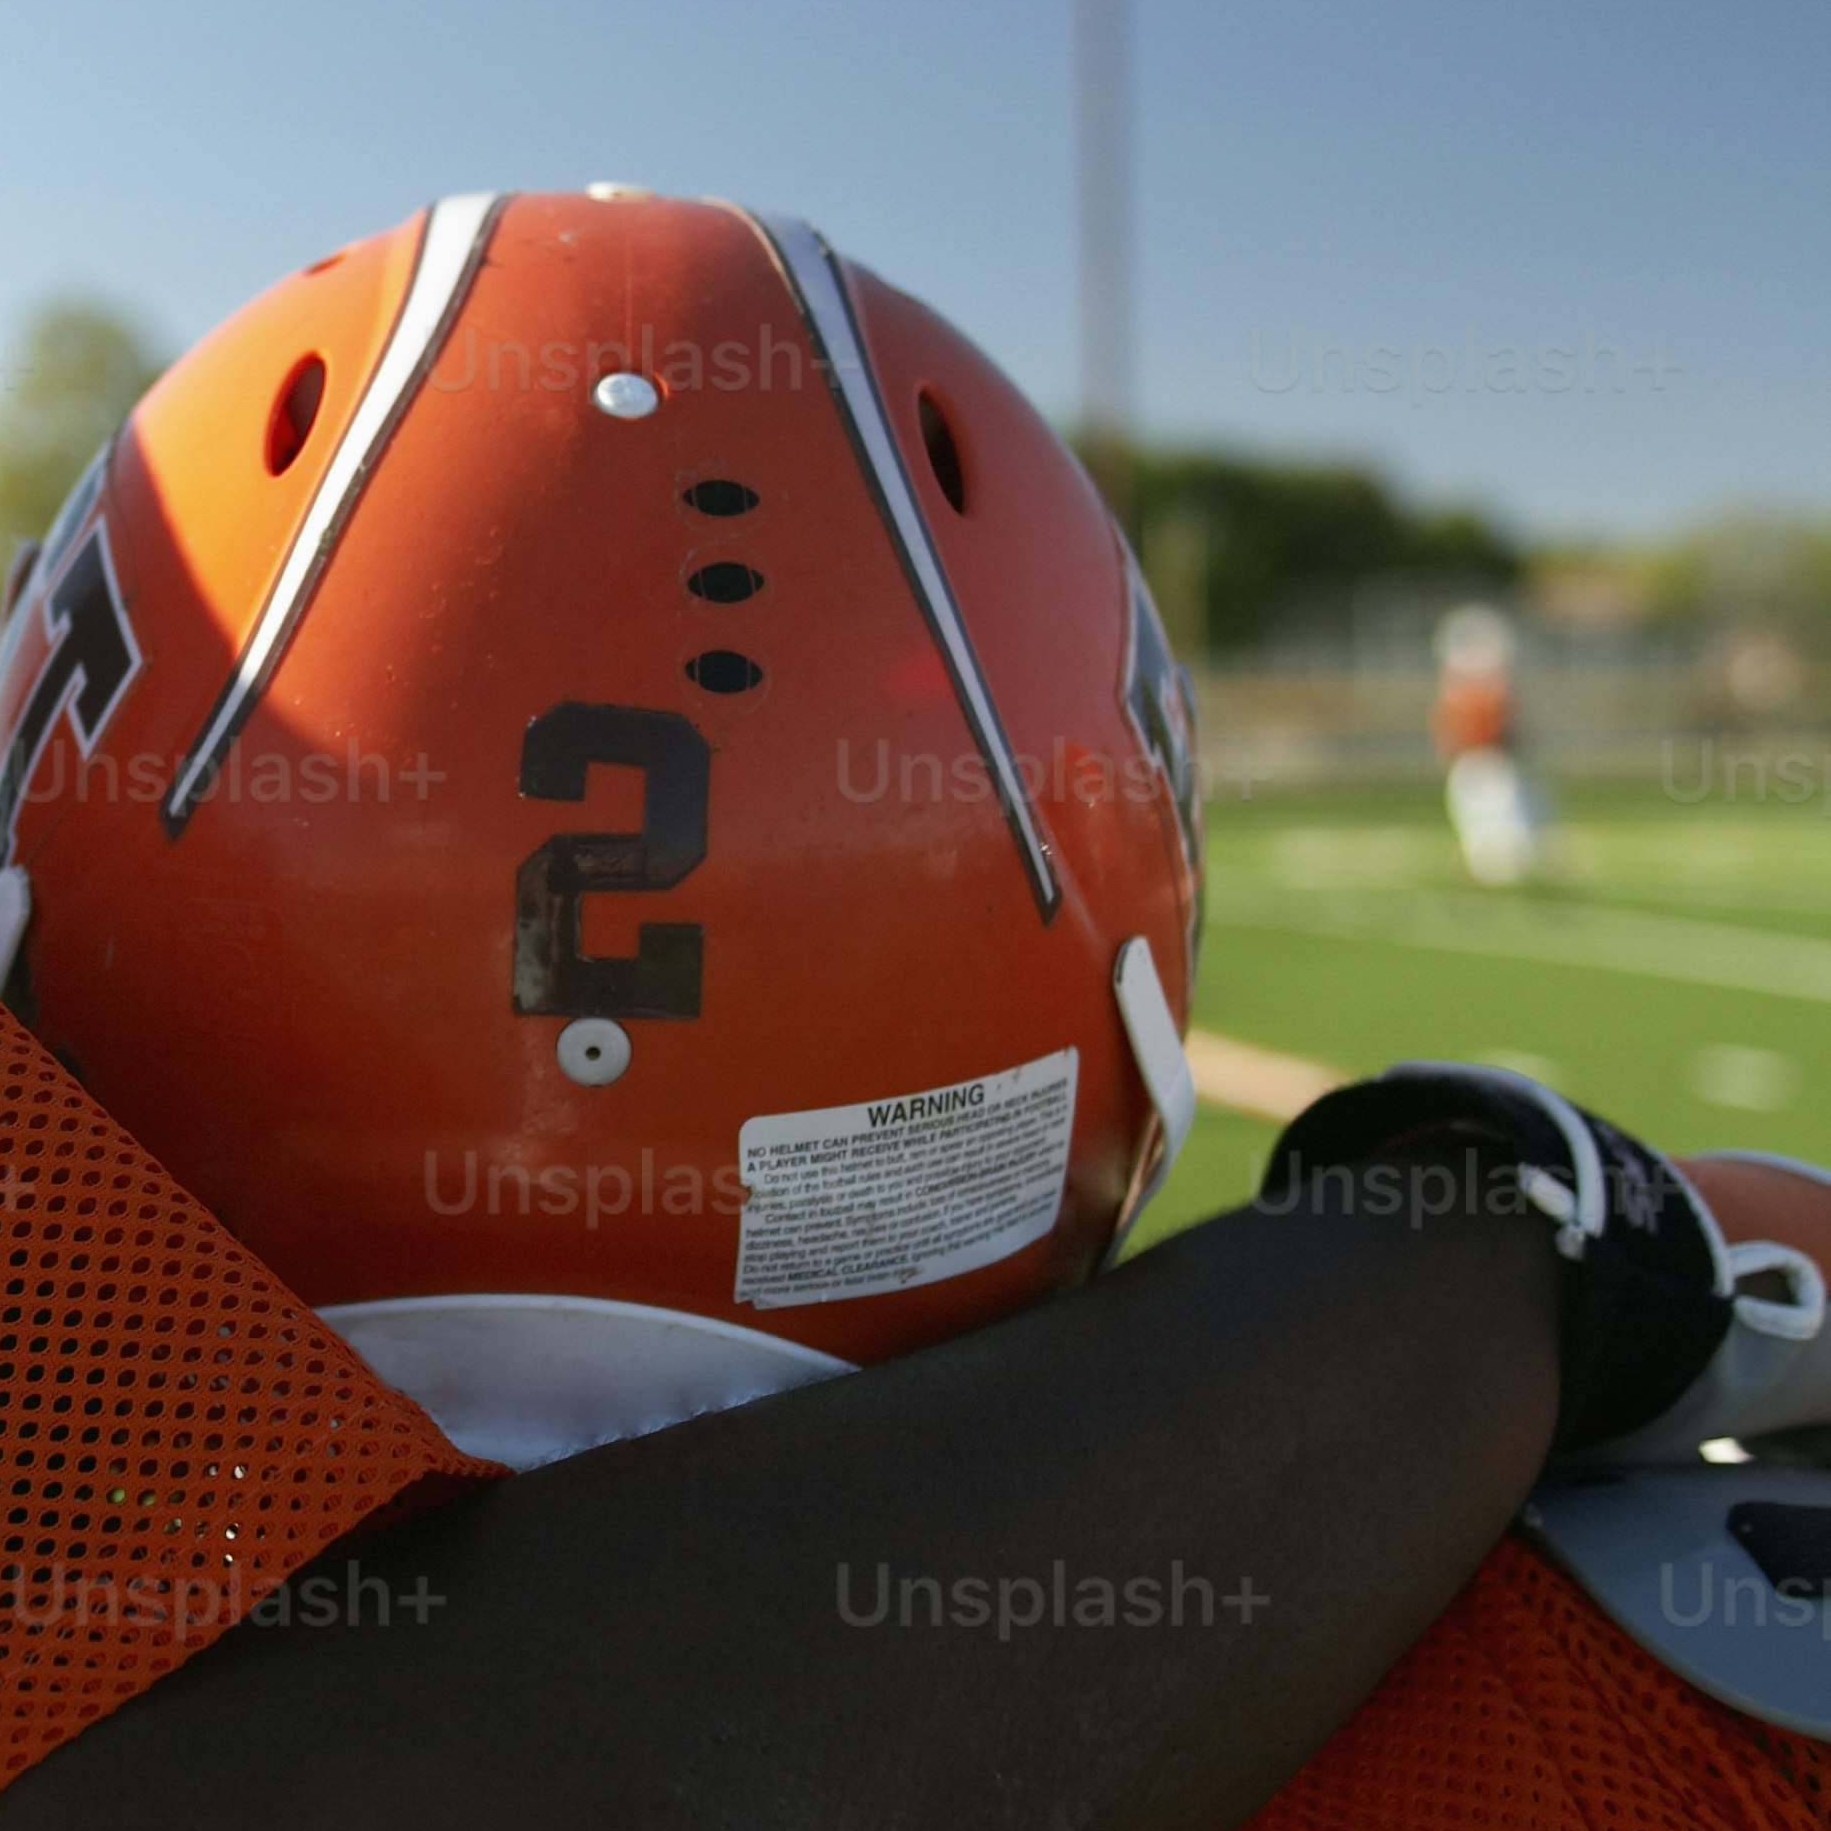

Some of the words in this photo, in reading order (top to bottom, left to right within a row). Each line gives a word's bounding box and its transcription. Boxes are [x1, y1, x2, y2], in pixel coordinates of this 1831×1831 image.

[512, 700, 711, 1019] 2
[867, 1083, 985, 1127] WARNING
[747, 1147, 766, 1157] NO
[770, 1140, 819, 1155] HELMET
[822, 1136, 848, 1149] CAN
[851, 1126, 904, 1144] PREVENT
[908, 1115, 954, 1134] SERIOUS
[957, 1106, 986, 1123] HEAD
[747, 1162, 756, 1171] A
[759, 1156, 807, 1170] PLAYER
[810, 1150, 848, 1163] MIGHT
[851, 1140, 900, 1157] RECEIVE
[903, 1132, 935, 1148] WHILE
[939, 1111, 1011, 1139] PARTICIPATING
[841, 1159, 873, 1172] helmet
[822, 1175, 856, 1189] football
[765, 1211, 805, 1224] Contact
[746, 1226, 781, 1238] helmet
[788, 1266, 838, 1281] MEDICAL
